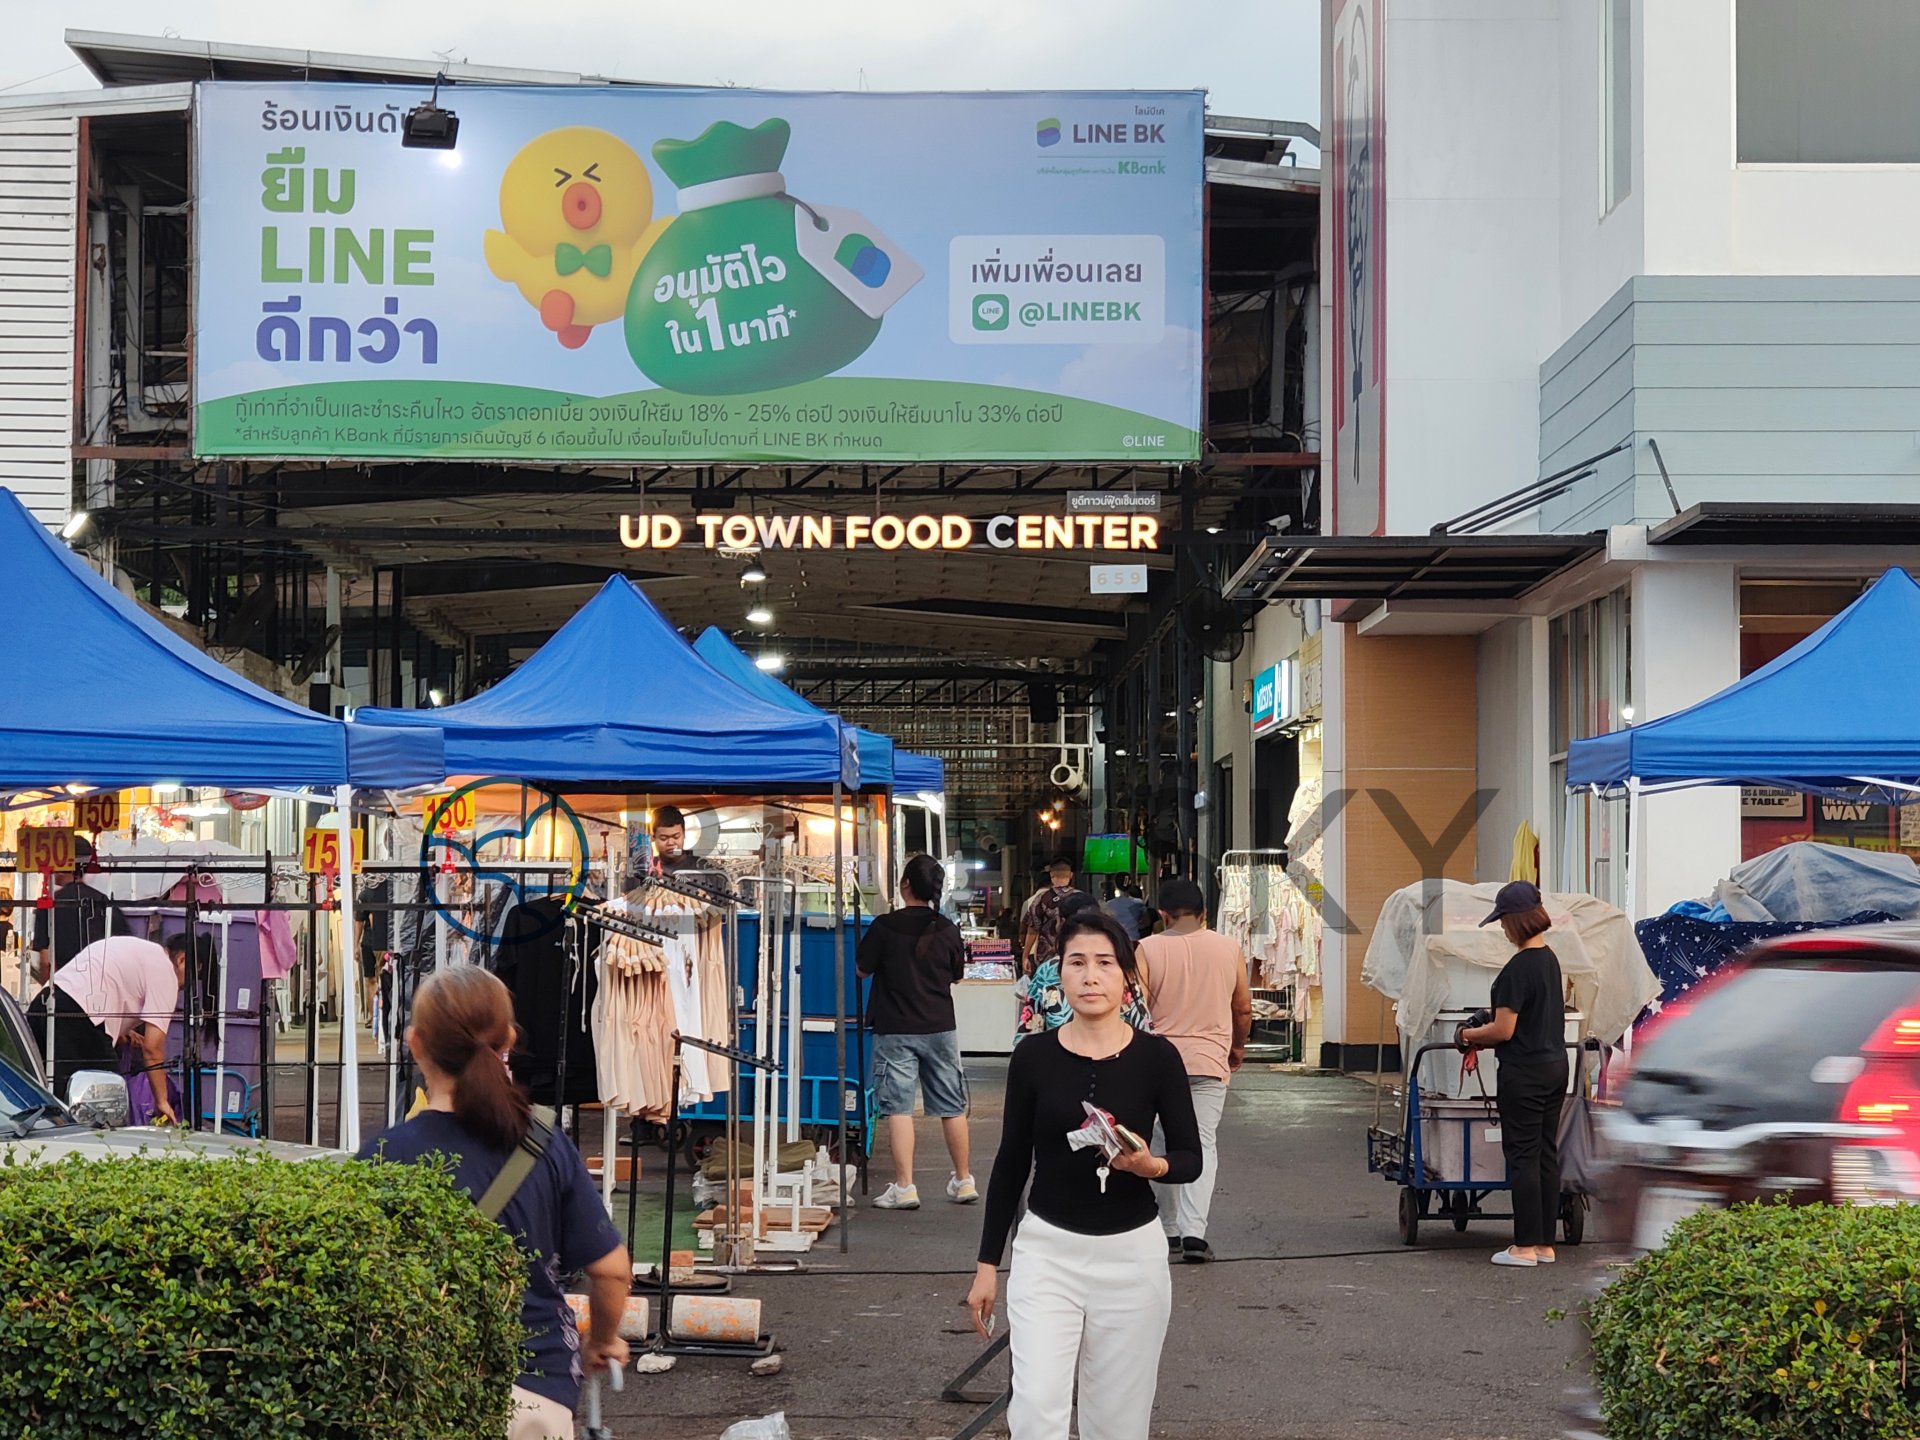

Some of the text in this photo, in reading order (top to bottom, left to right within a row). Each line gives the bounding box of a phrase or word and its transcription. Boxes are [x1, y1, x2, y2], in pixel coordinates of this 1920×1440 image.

[1073, 123, 1166, 143] LINE BK
[261, 147, 356, 215] ยืม
[1118, 161, 1166, 175] KBank
[261, 227, 435, 286] LINE
[971, 248, 1142, 283] เพิ่มเพื่อนเลย
[653, 243, 787, 309] อนุมัติไว
[981, 307, 1001, 315] LINE
[1018, 302, 1142, 328] @LINEBK
[256, 296, 438, 364] ดีกว่า
[664, 319, 703, 355] ใน
[689, 404, 729, 422] 18%
[748, 403, 791, 423] 25%
[796, 404, 833, 424] ต่อปี
[978, 405, 1021, 423] 33%
[1026, 404, 1064, 424] ต่อปี
[335, 428, 388, 443] KBank
[536, 431, 546, 446] 6
[763, 432, 801, 446] LINE
[806, 433, 828, 447] BK
[833, 432, 882, 447] กำหนด
[619, 514, 1158, 549] UD TOWN FOOD CENTER
[1822, 805, 1870, 820] WAY
